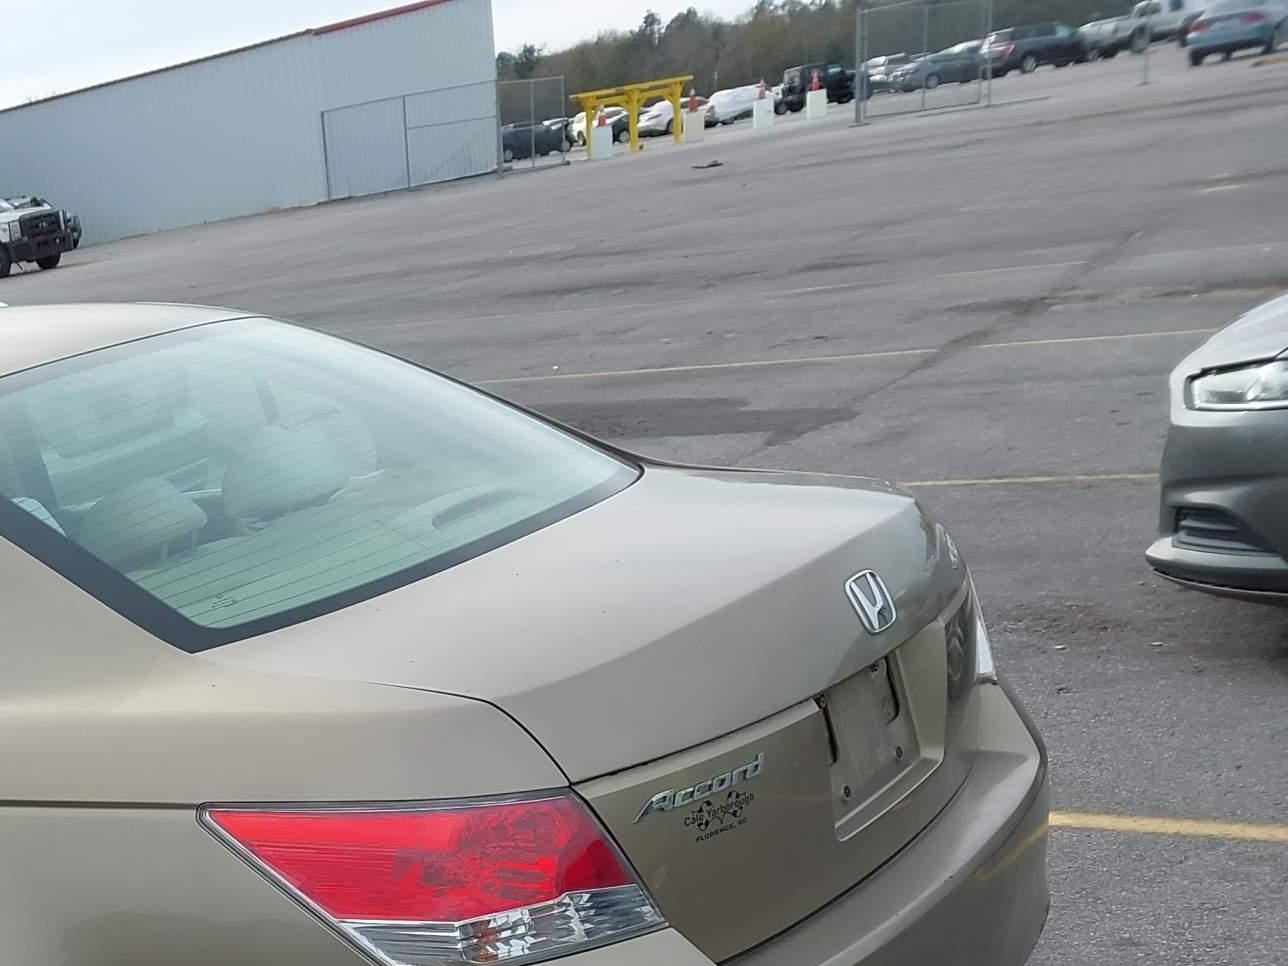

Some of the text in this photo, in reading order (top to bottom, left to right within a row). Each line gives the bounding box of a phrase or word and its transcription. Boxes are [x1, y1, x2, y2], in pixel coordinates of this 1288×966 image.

[632, 752, 764, 824] Accord
[684, 793, 755, 827] Cale Yarborough
